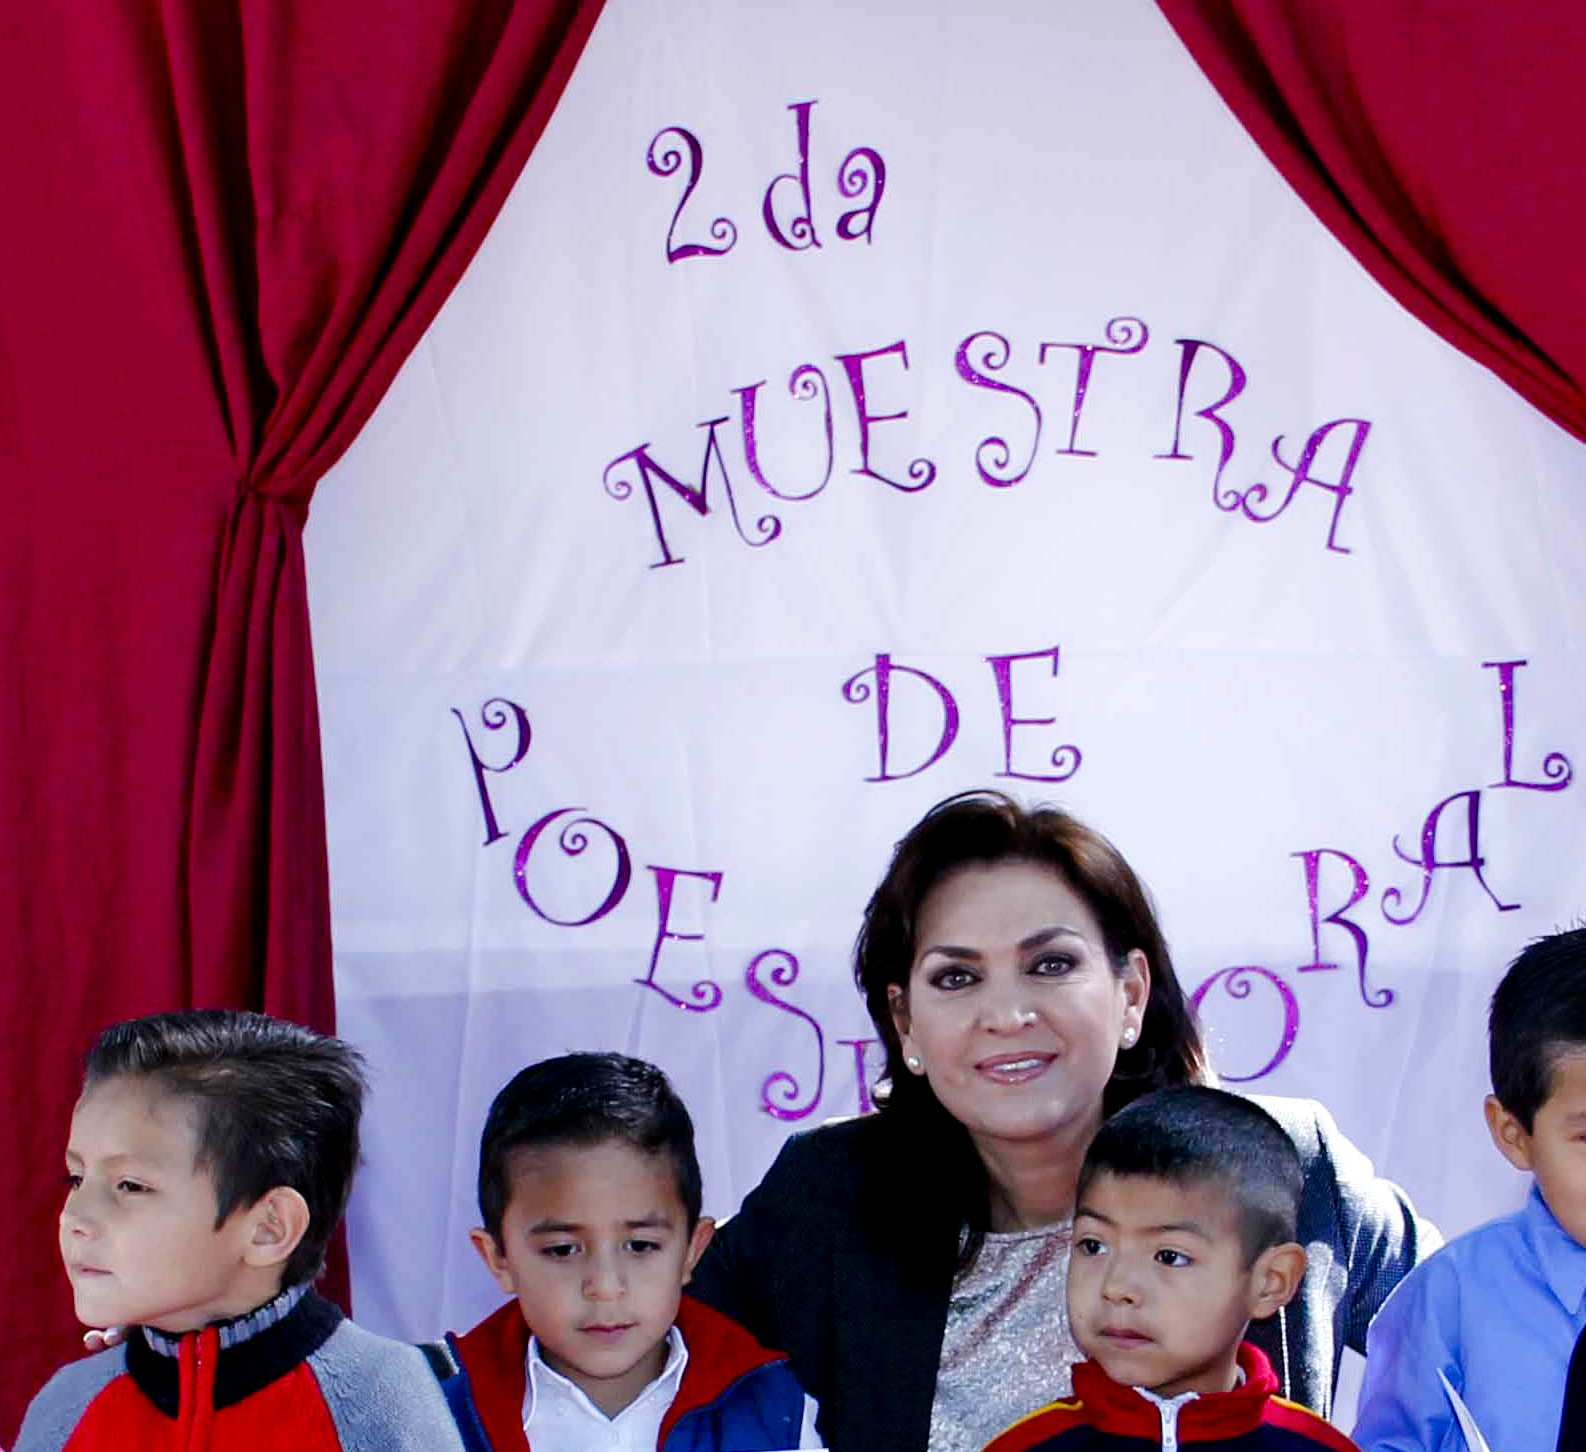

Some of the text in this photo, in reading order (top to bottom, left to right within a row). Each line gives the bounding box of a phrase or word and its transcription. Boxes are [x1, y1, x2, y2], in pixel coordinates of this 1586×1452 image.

[603, 317, 1373, 568] MUESTRA
[842, 646, 1082, 783] DE
[1188, 660, 1572, 1081] ORAL
